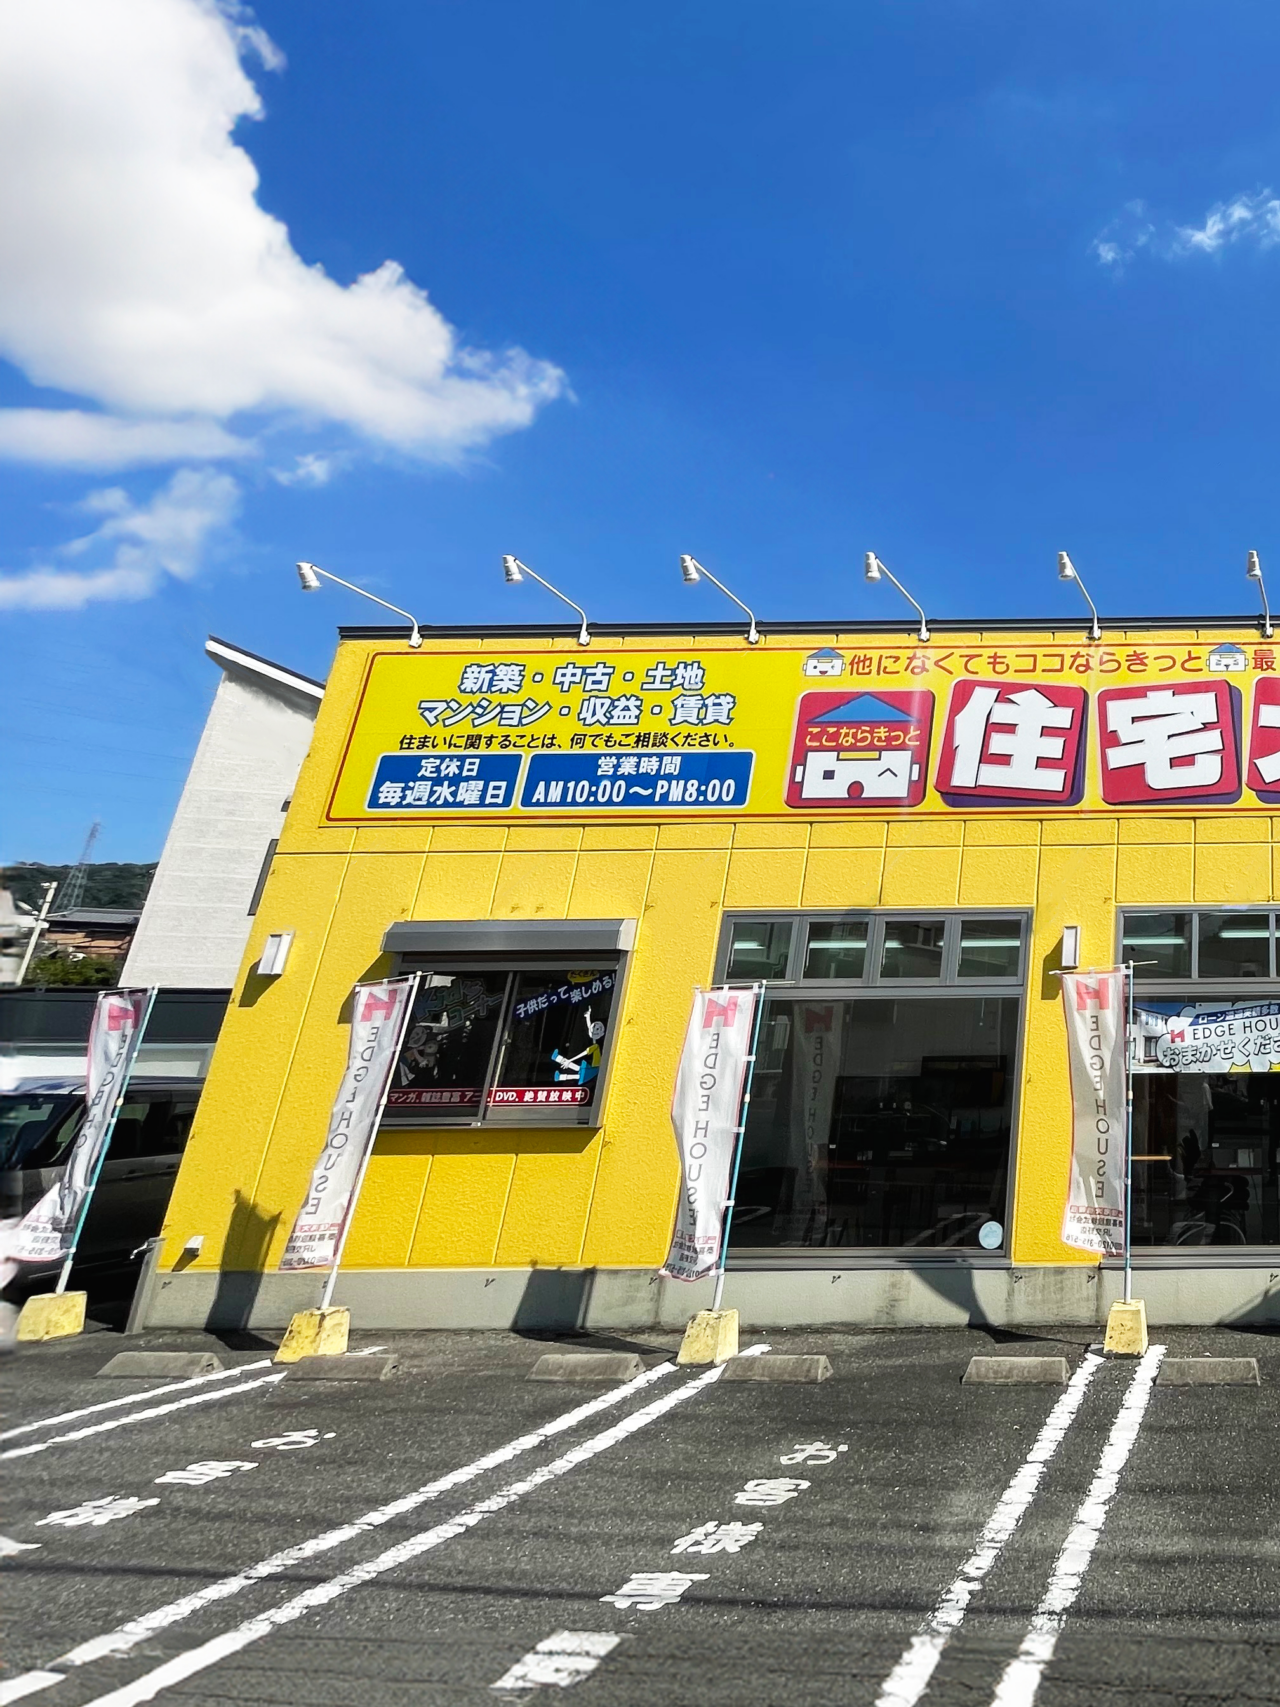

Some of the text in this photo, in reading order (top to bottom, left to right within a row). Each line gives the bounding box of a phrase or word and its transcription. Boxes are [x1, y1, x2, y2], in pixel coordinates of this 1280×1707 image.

[848, 652, 1203, 677] 他になくてもココならきっと
[458, 660, 706, 695] 新築・中古・土地
[417, 694, 737, 728] マンション・収益・賃貸
[398, 732, 737, 751] 住まいに関することは、何でもご相談ください。
[804, 725, 921, 747] ここならきっと
[417, 758, 480, 777] 定休日
[597, 756, 681, 775] 営業時間
[377, 780, 507, 806] 毎週水曜日
[1193, 1023, 1236, 1041] EDGE
